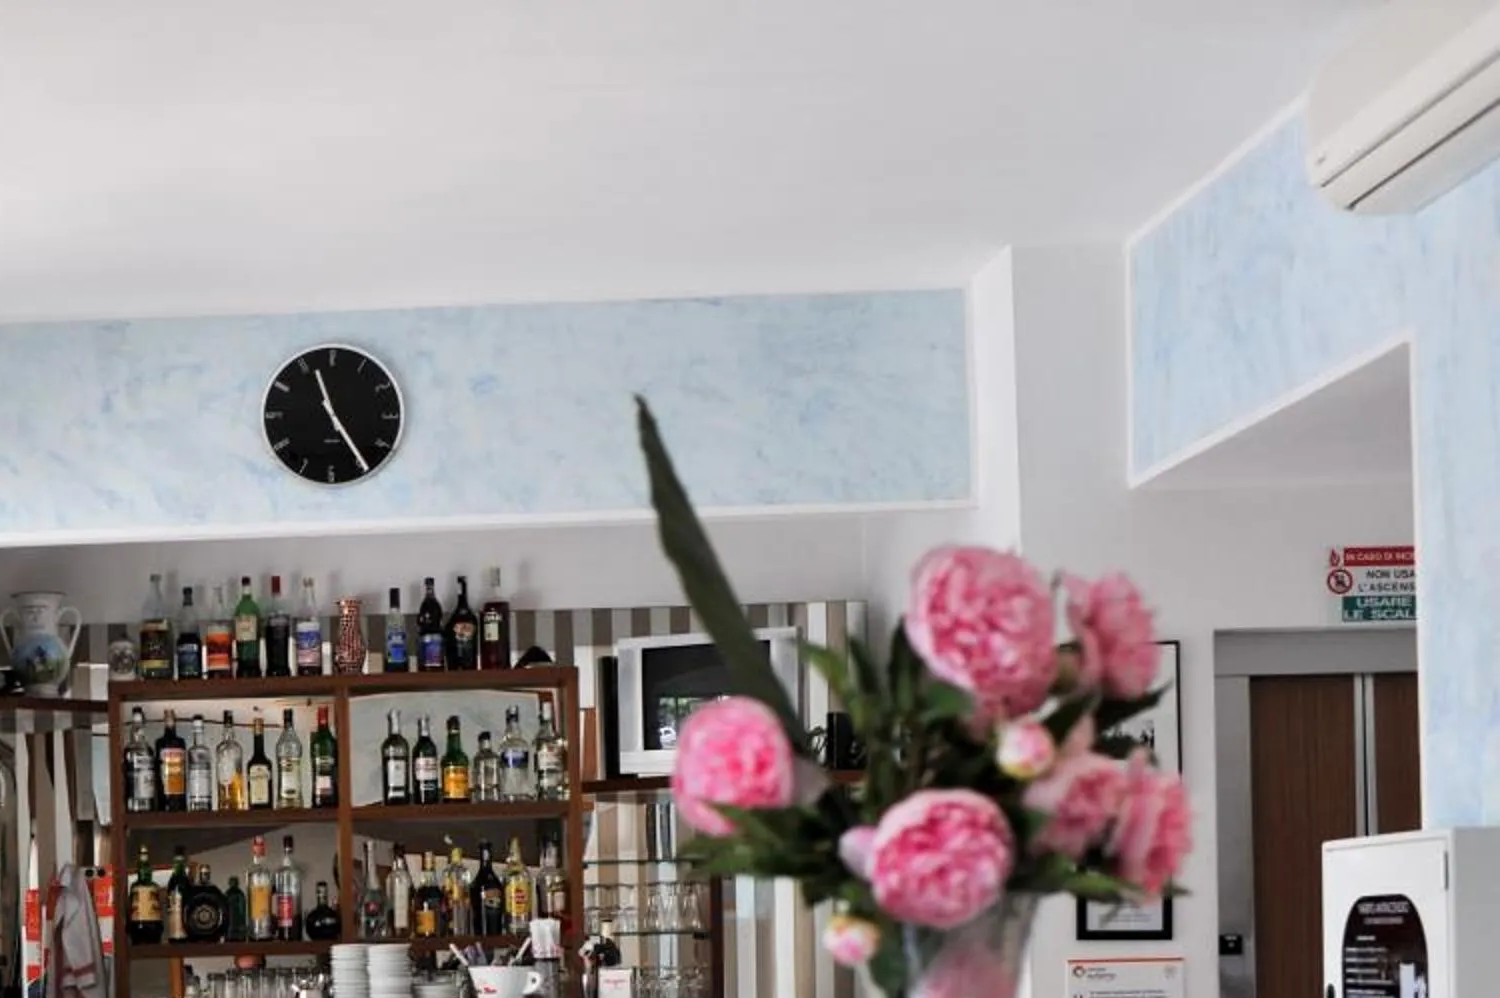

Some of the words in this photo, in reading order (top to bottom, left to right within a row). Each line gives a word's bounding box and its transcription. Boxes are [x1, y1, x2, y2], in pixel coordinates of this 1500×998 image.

[1366, 568, 1390, 579] NON
[1356, 597, 1413, 607] USARE
[1344, 608, 1364, 619] LE
